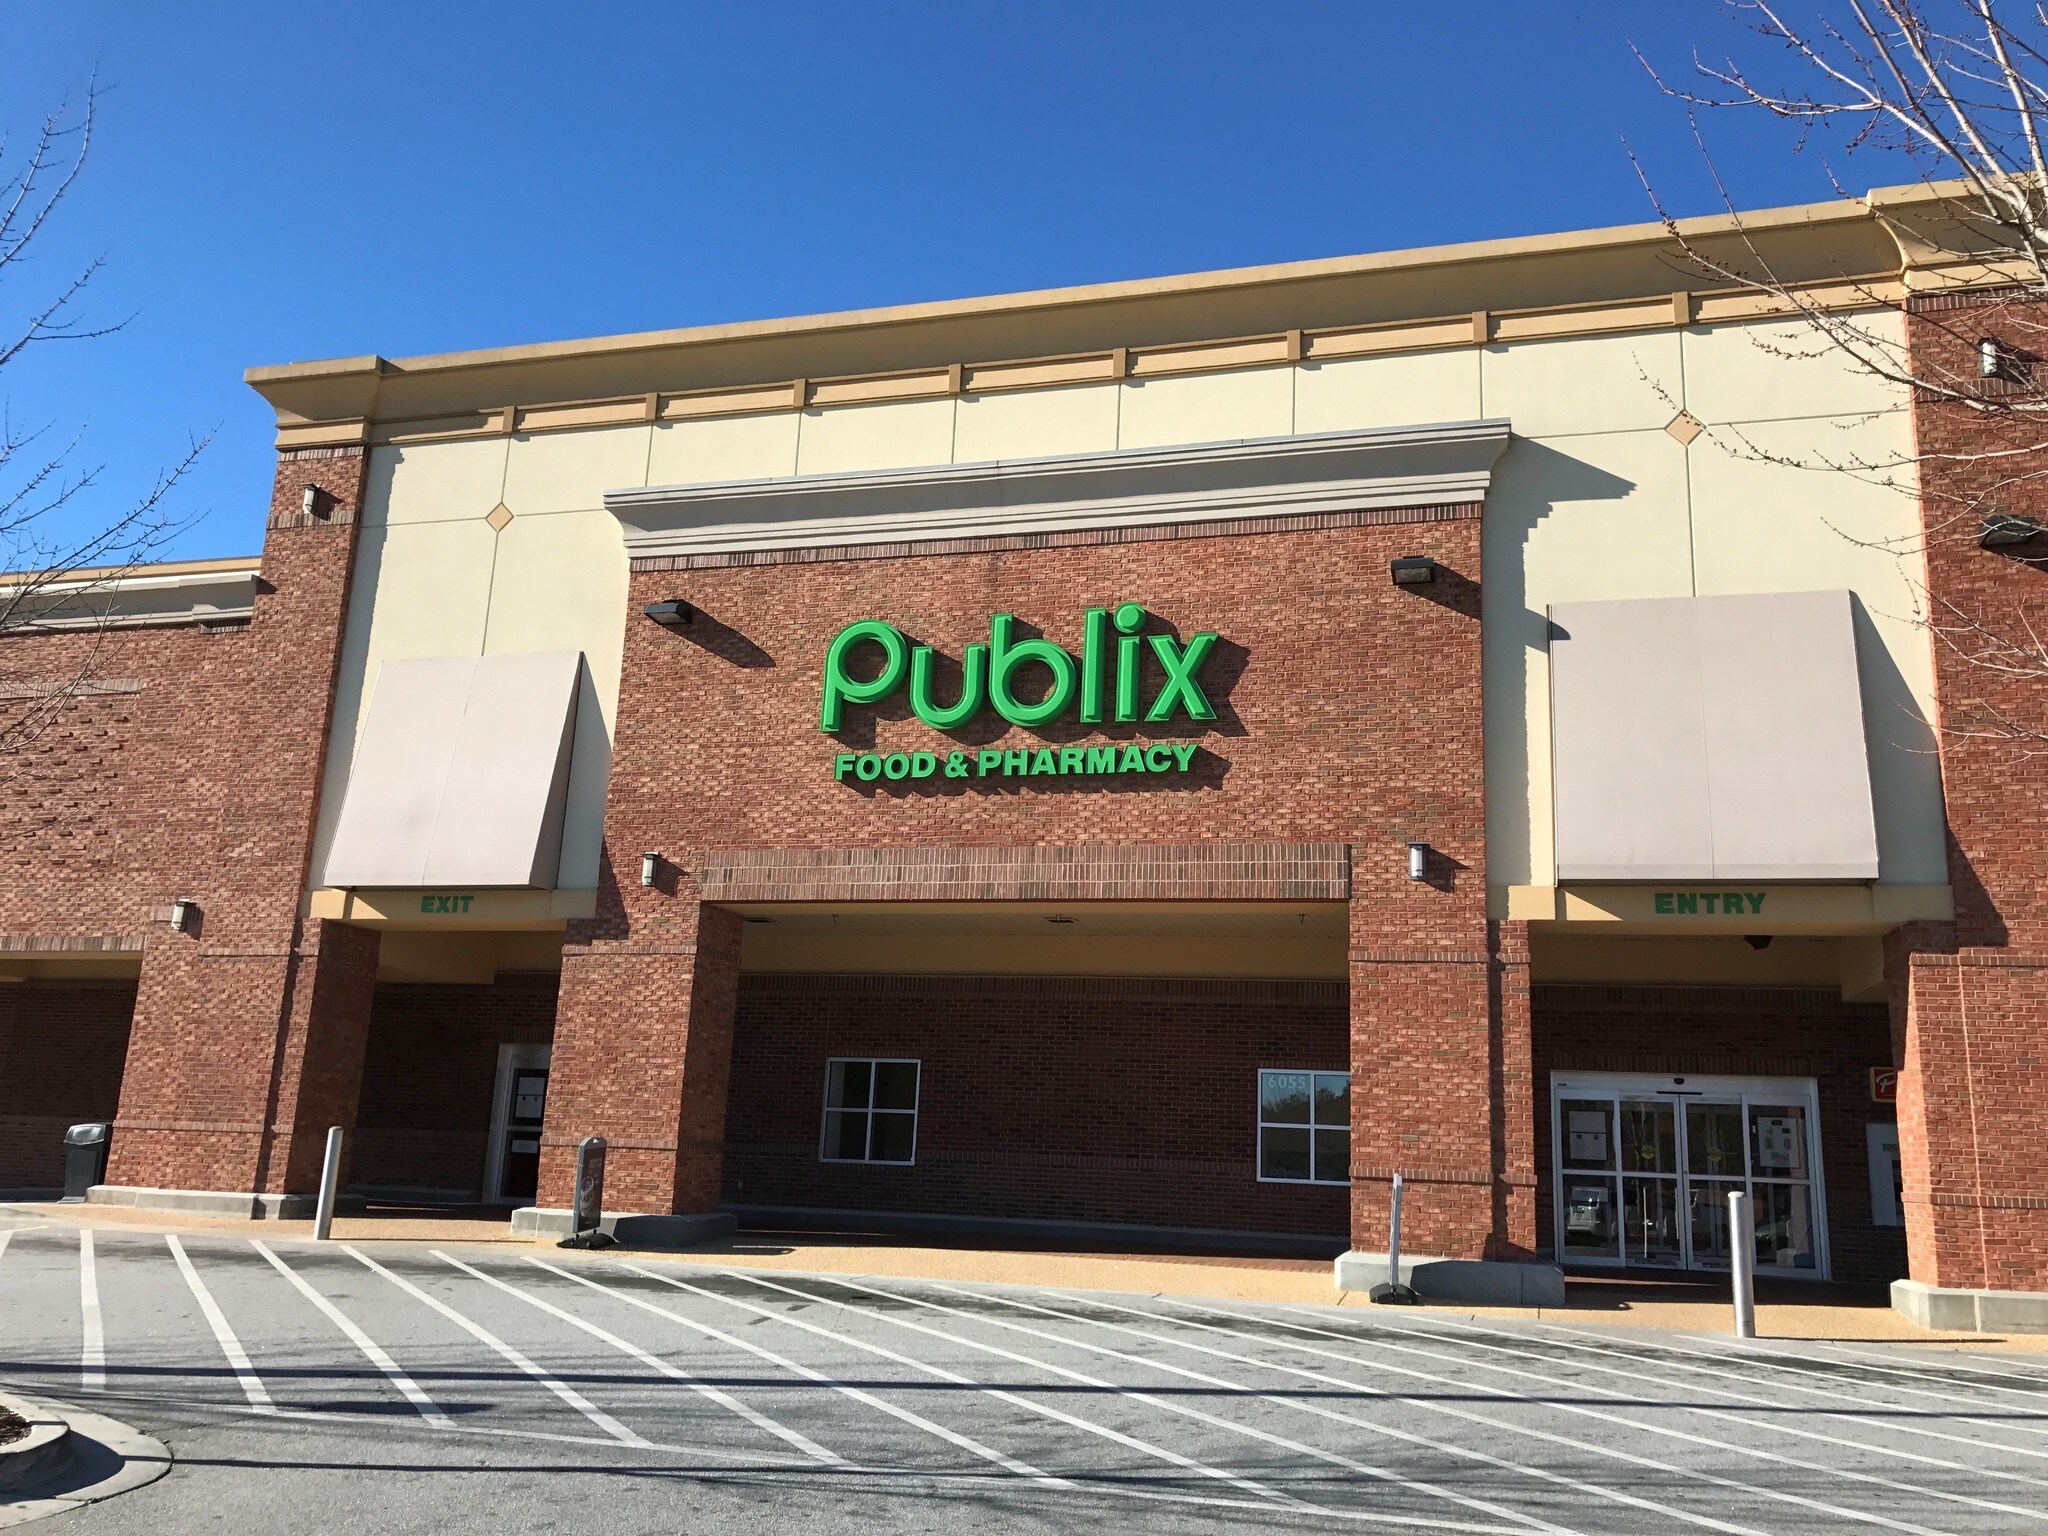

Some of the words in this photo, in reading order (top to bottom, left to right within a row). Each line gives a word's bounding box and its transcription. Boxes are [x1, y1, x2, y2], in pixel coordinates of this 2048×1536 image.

[820, 601, 1219, 732] Publix
[834, 752, 937, 781] FOOD
[943, 751, 969, 778] &
[977, 744, 1199, 777] PHARMACY
[421, 895, 474, 913] EXIT
[1655, 892, 1767, 914] ENTRY
[1267, 1075, 1306, 1089] 6055
